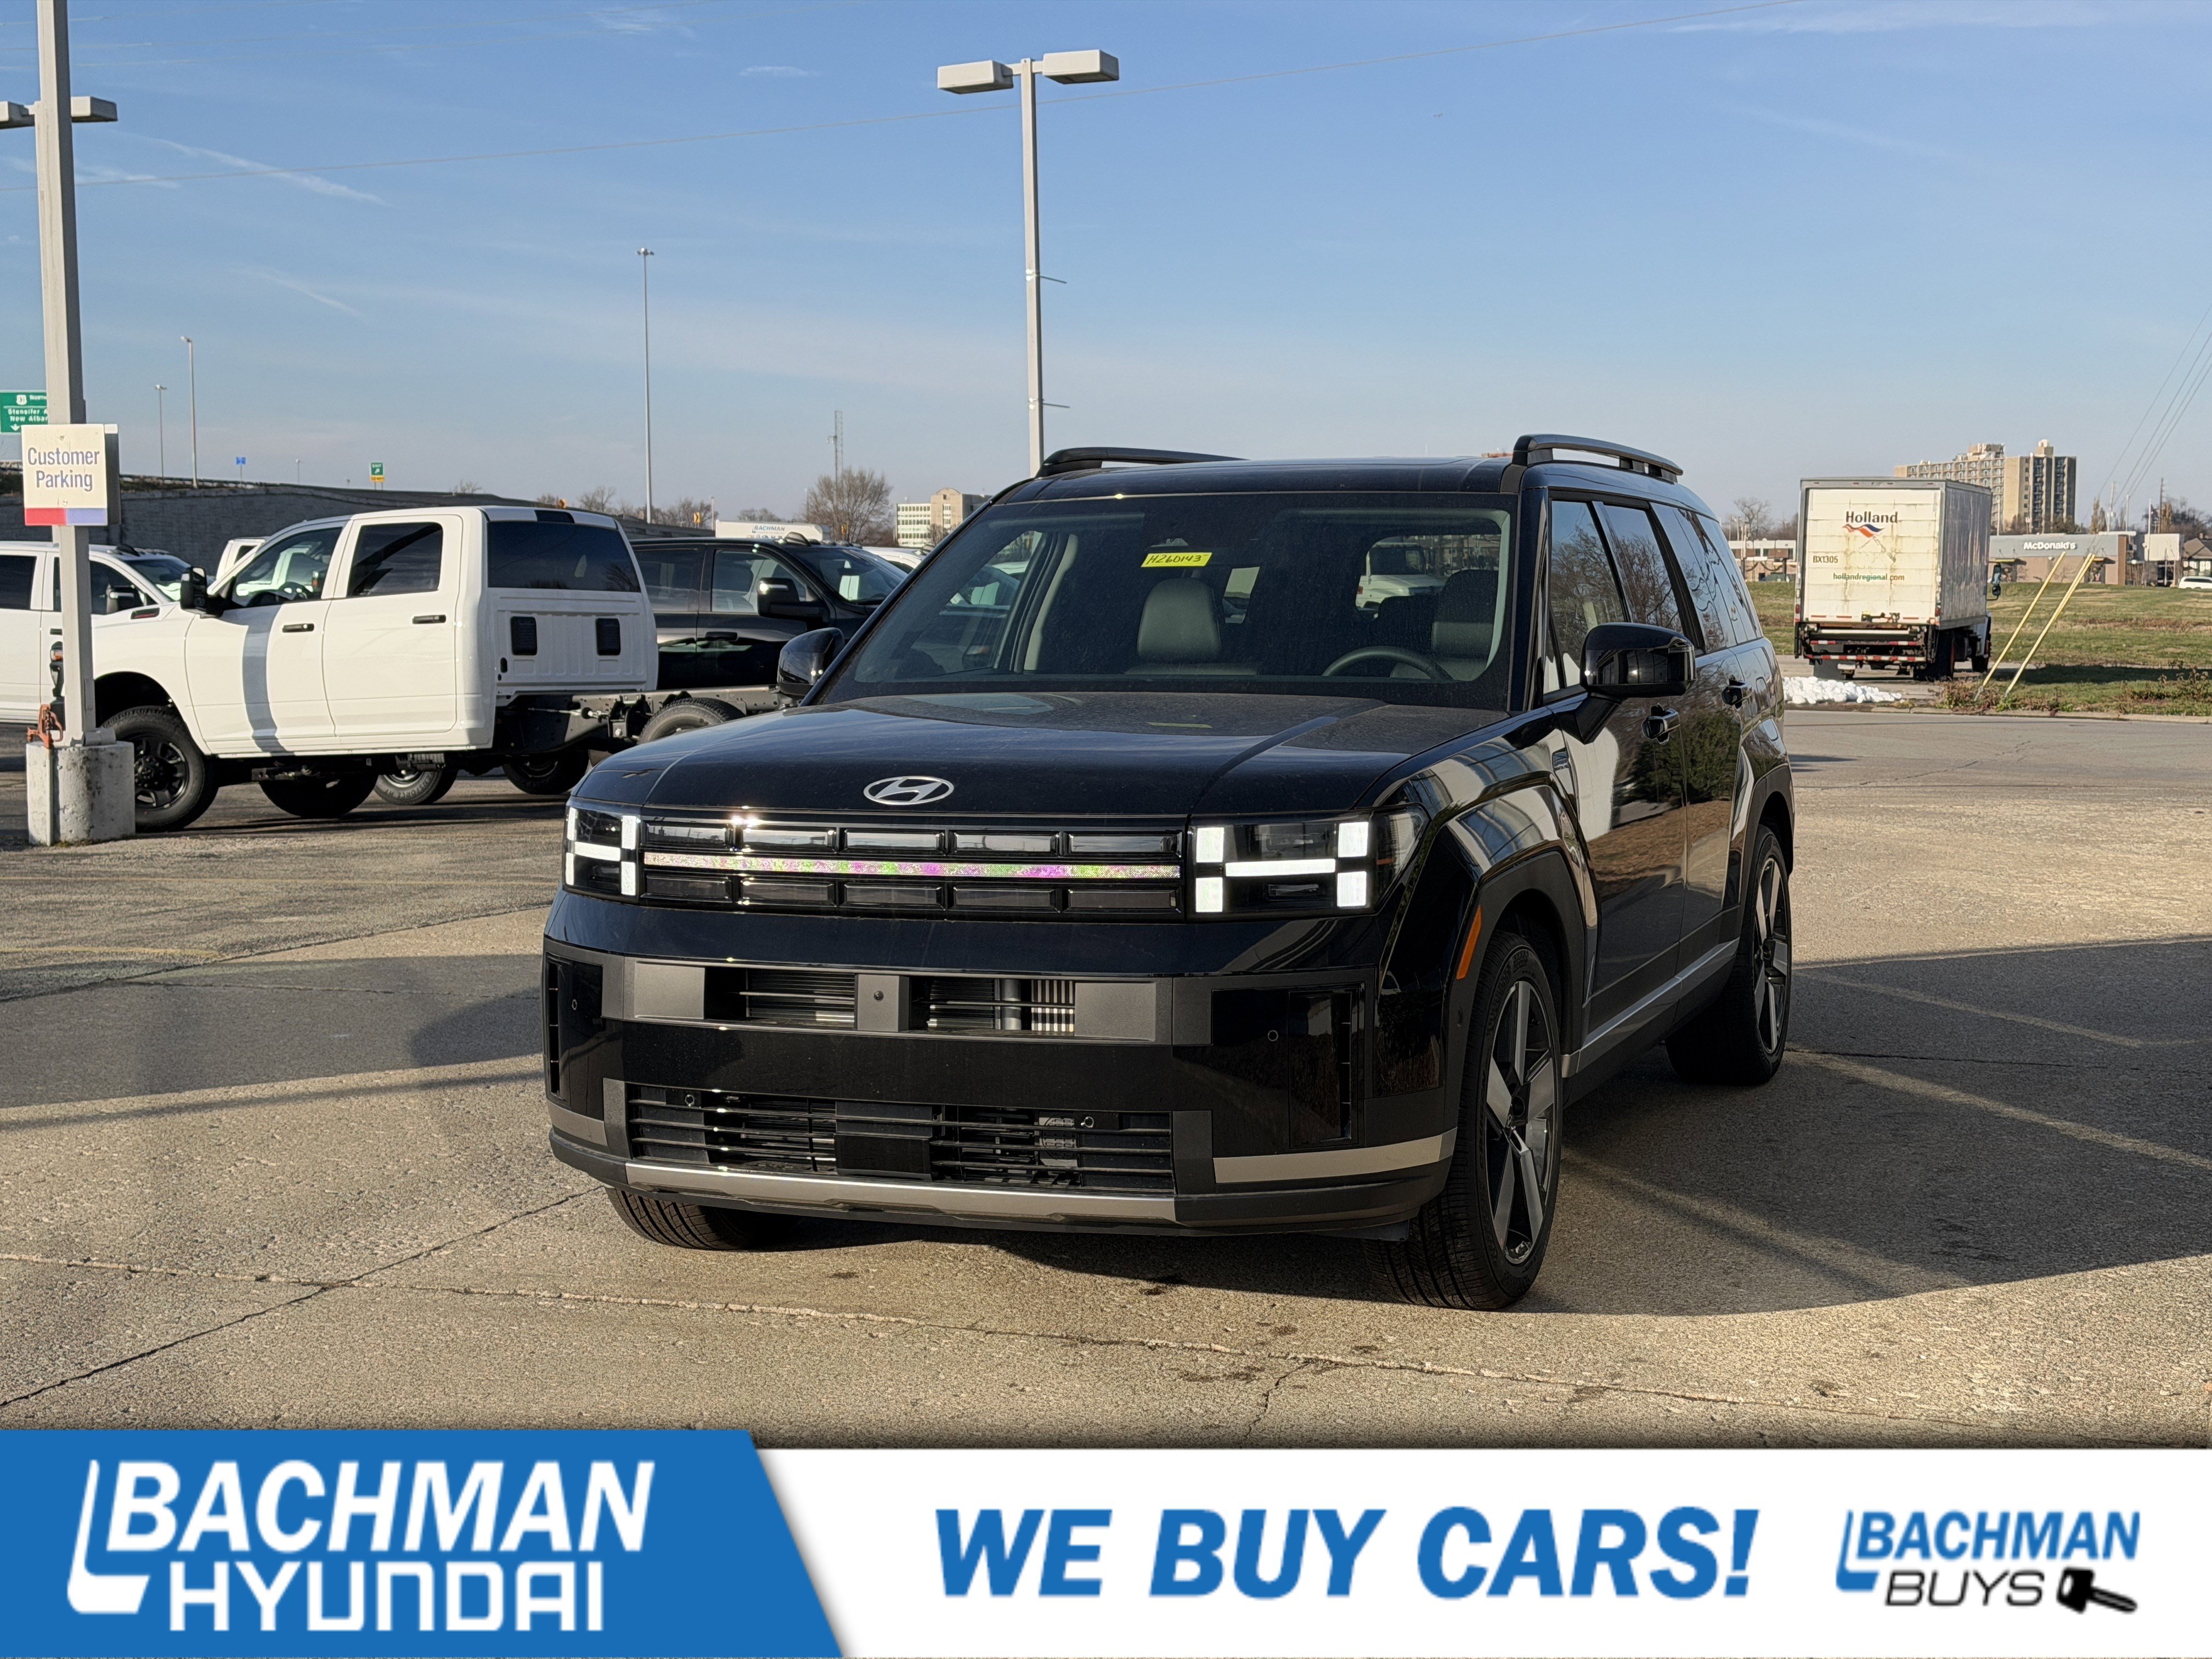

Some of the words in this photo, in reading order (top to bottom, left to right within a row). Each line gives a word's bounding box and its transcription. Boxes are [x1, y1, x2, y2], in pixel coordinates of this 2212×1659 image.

[27, 447, 100, 465] Customer
[36, 469, 93, 492] Parking
[1846, 511, 1898, 523] Holland
[2023, 541, 2076, 550] McDonald's
[1146, 554, 1202, 565] H260143
